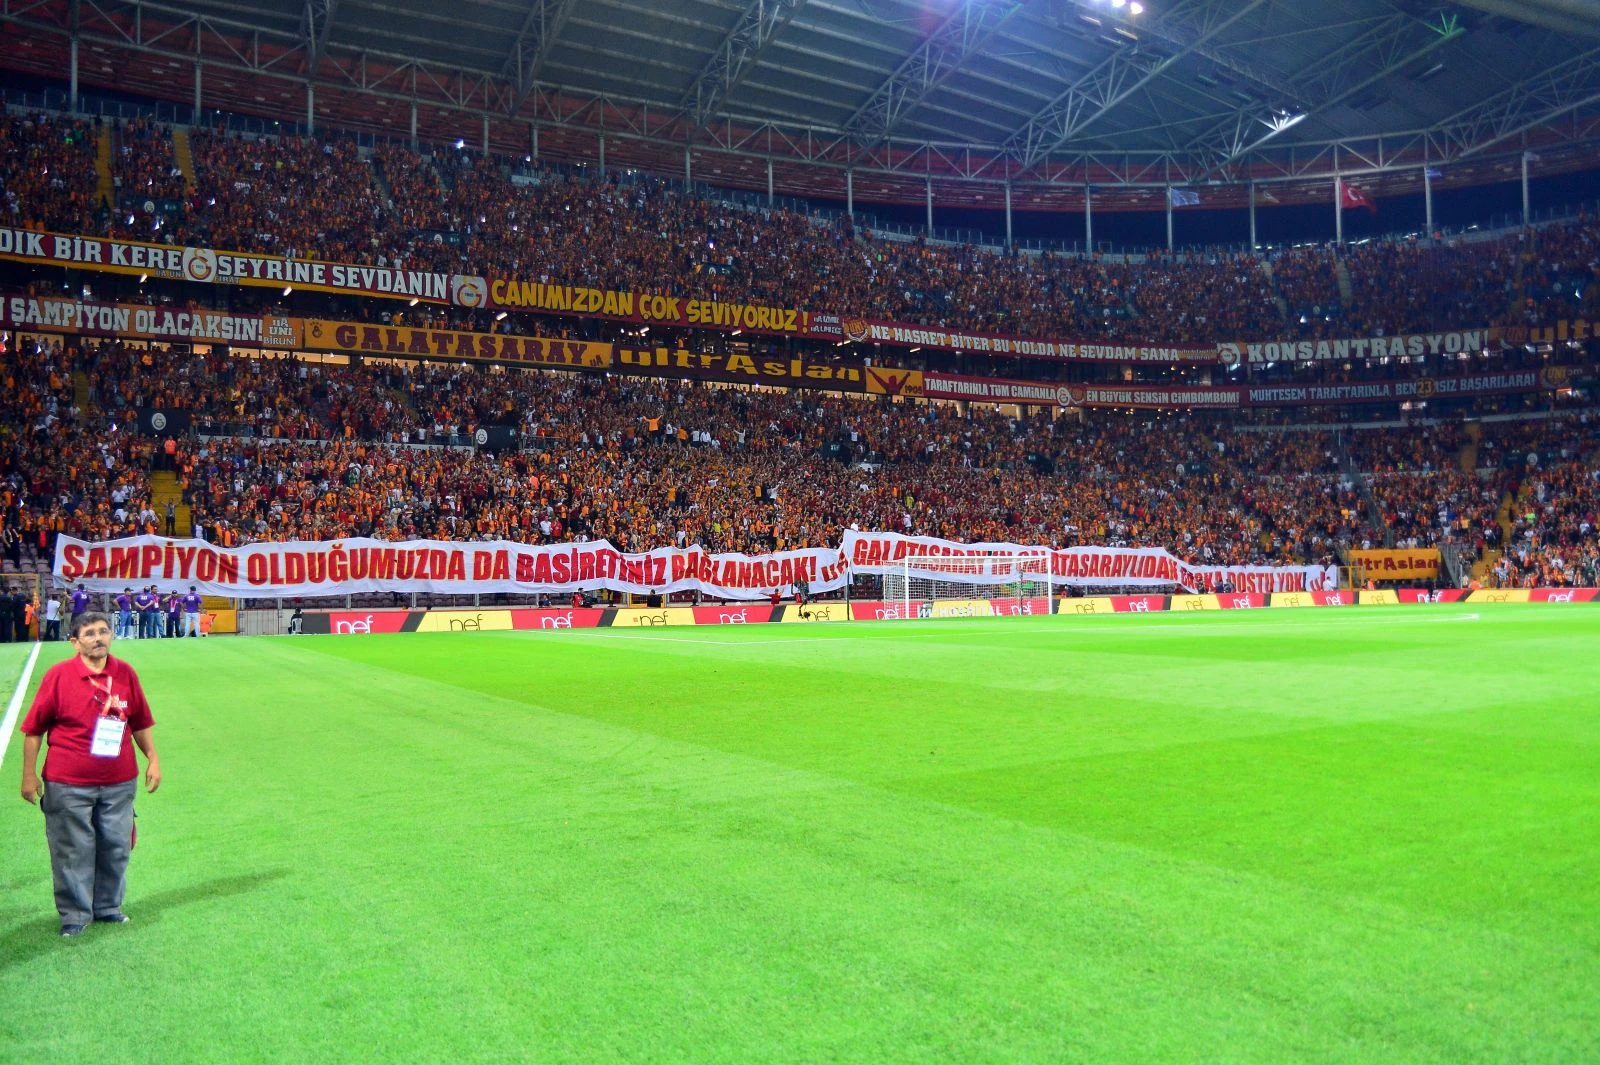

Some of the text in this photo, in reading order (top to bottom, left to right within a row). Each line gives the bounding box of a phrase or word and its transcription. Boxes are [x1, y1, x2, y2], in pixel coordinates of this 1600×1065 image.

[54, 236, 102, 262] BİR
[110, 243, 183, 271] KERE
[218, 256, 448, 299] SEYRİNE SEVDANIN
[491, 279, 634, 317] CANIMIZDAN
[639, 295, 681, 324] ÇOK
[685, 299, 797, 333] SEVİYORUZ
[11, 300, 131, 331] ŞAMPİYON
[135, 310, 263, 342] OLACAKSIN!
[335, 325, 589, 367] GALATASARAY
[871, 324, 889, 340] NE
[893, 328, 947, 347] HASRET
[950, 330, 989, 351] BİTER
[993, 337, 1009, 352] BU
[1013, 340, 1056, 356] YOLDA
[1059, 344, 1076, 358] NE
[1080, 345, 1136, 361] SEVDAM
[1140, 348, 1180, 361] SANA
[1247, 331, 1489, 362] KONSANTRASYON!
[904, 383, 922, 394] 1905
[924, 377, 989, 396] TARAFTARINLA
[1086, 391, 1098, 402] EN
[62, 541, 239, 585] ŞAMPİYON
[247, 543, 465, 585] OLDUĞUMUZDA
[473, 549, 510, 581] DA
[1128, 597, 1148, 613] nef
[1185, 597, 1204, 611] nef
[1233, 595, 1251, 609] nef
[1325, 592, 1342, 606] nef
[1547, 590, 1574, 605] nef
[719, 608, 748, 625] nef
[1076, 600, 1096, 615] nef
[336, 614, 374, 635] nef
[449, 613, 482, 632] nef
[541, 611, 574, 630] nef
[639, 610, 668, 626] nef
